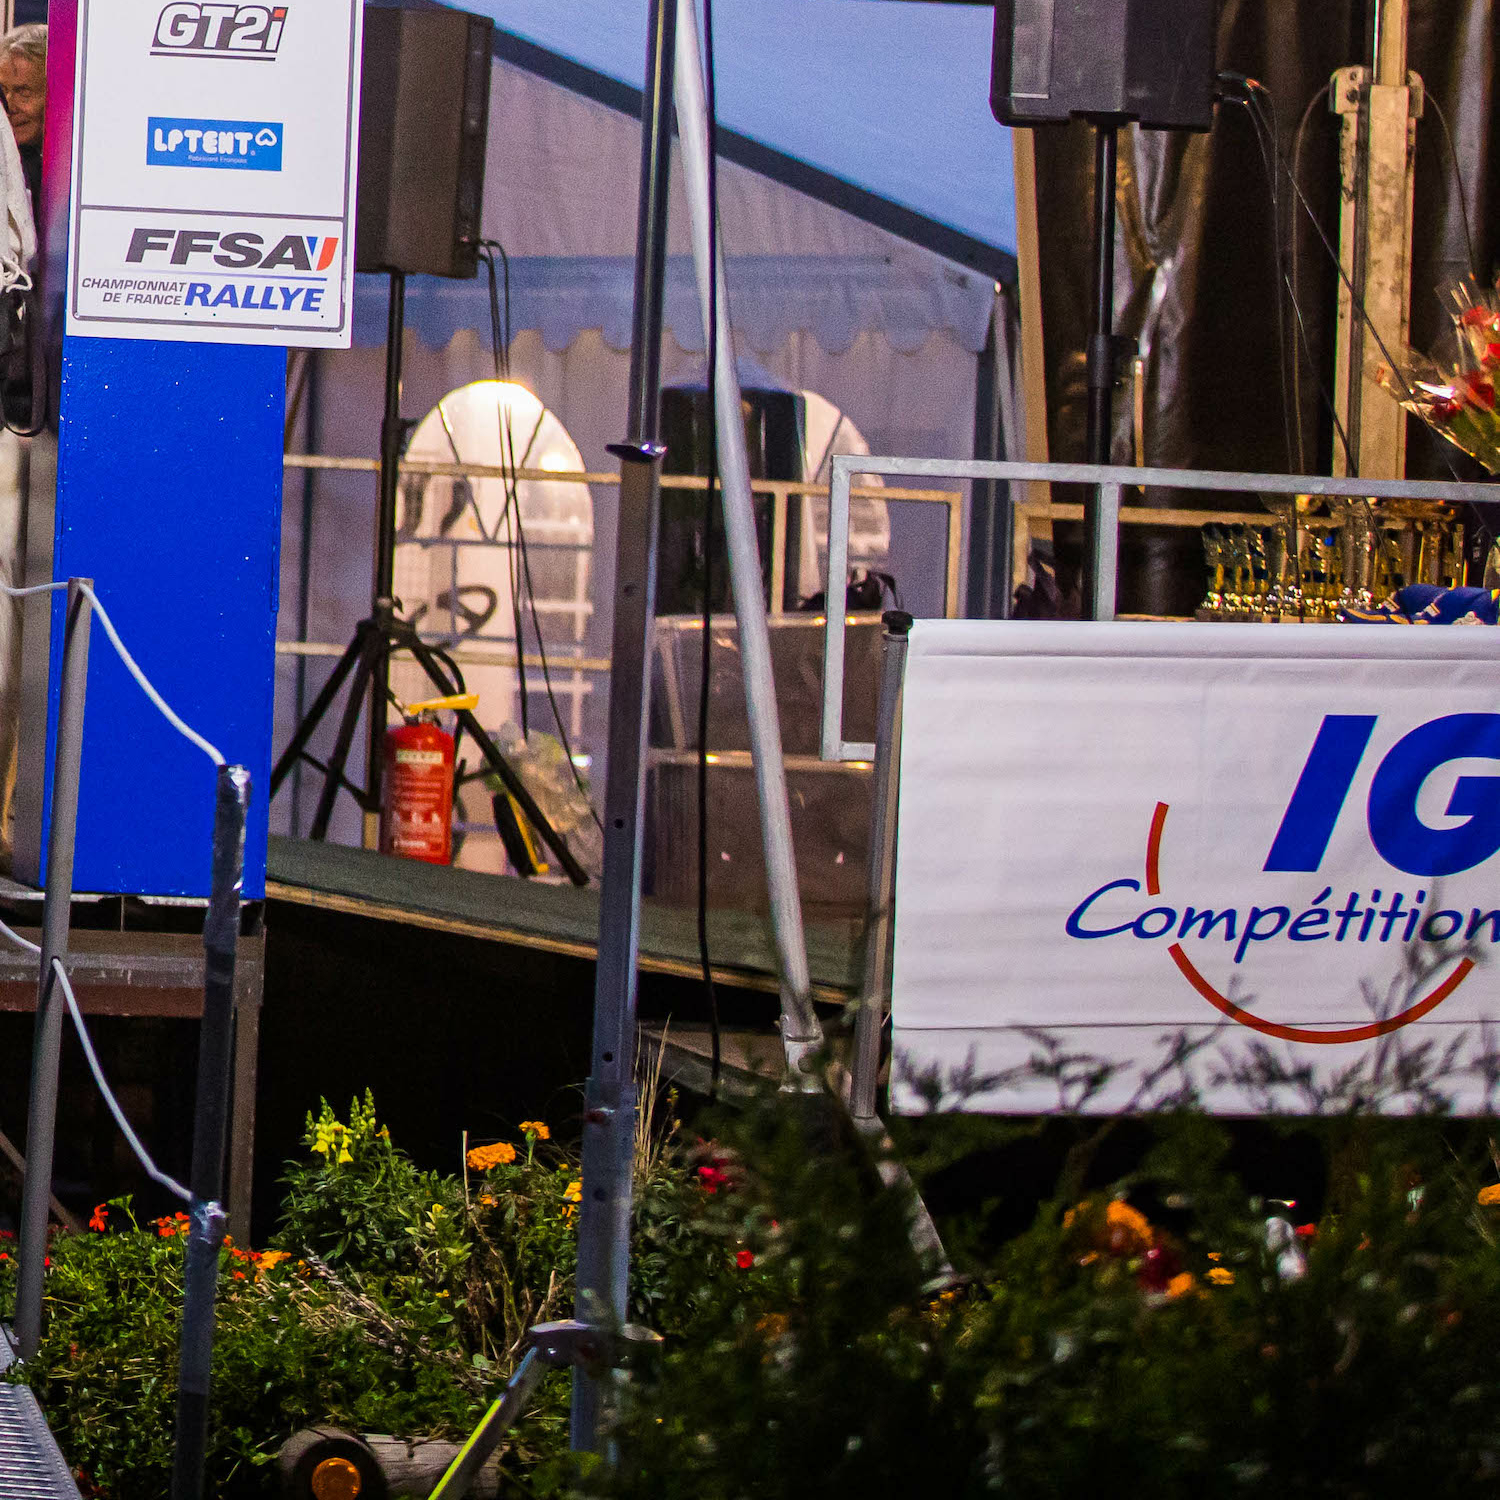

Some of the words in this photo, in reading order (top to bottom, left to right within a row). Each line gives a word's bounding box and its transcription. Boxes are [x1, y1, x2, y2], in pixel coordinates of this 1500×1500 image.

[125, 227, 313, 272] FFSA
[81, 277, 187, 295] CHAMPIONNAT
[102, 291, 124, 304] DE
[125, 292, 183, 306] FRANCE
[184, 282, 326, 314] RALLYE
[1065, 877, 1500, 964] Compétition
